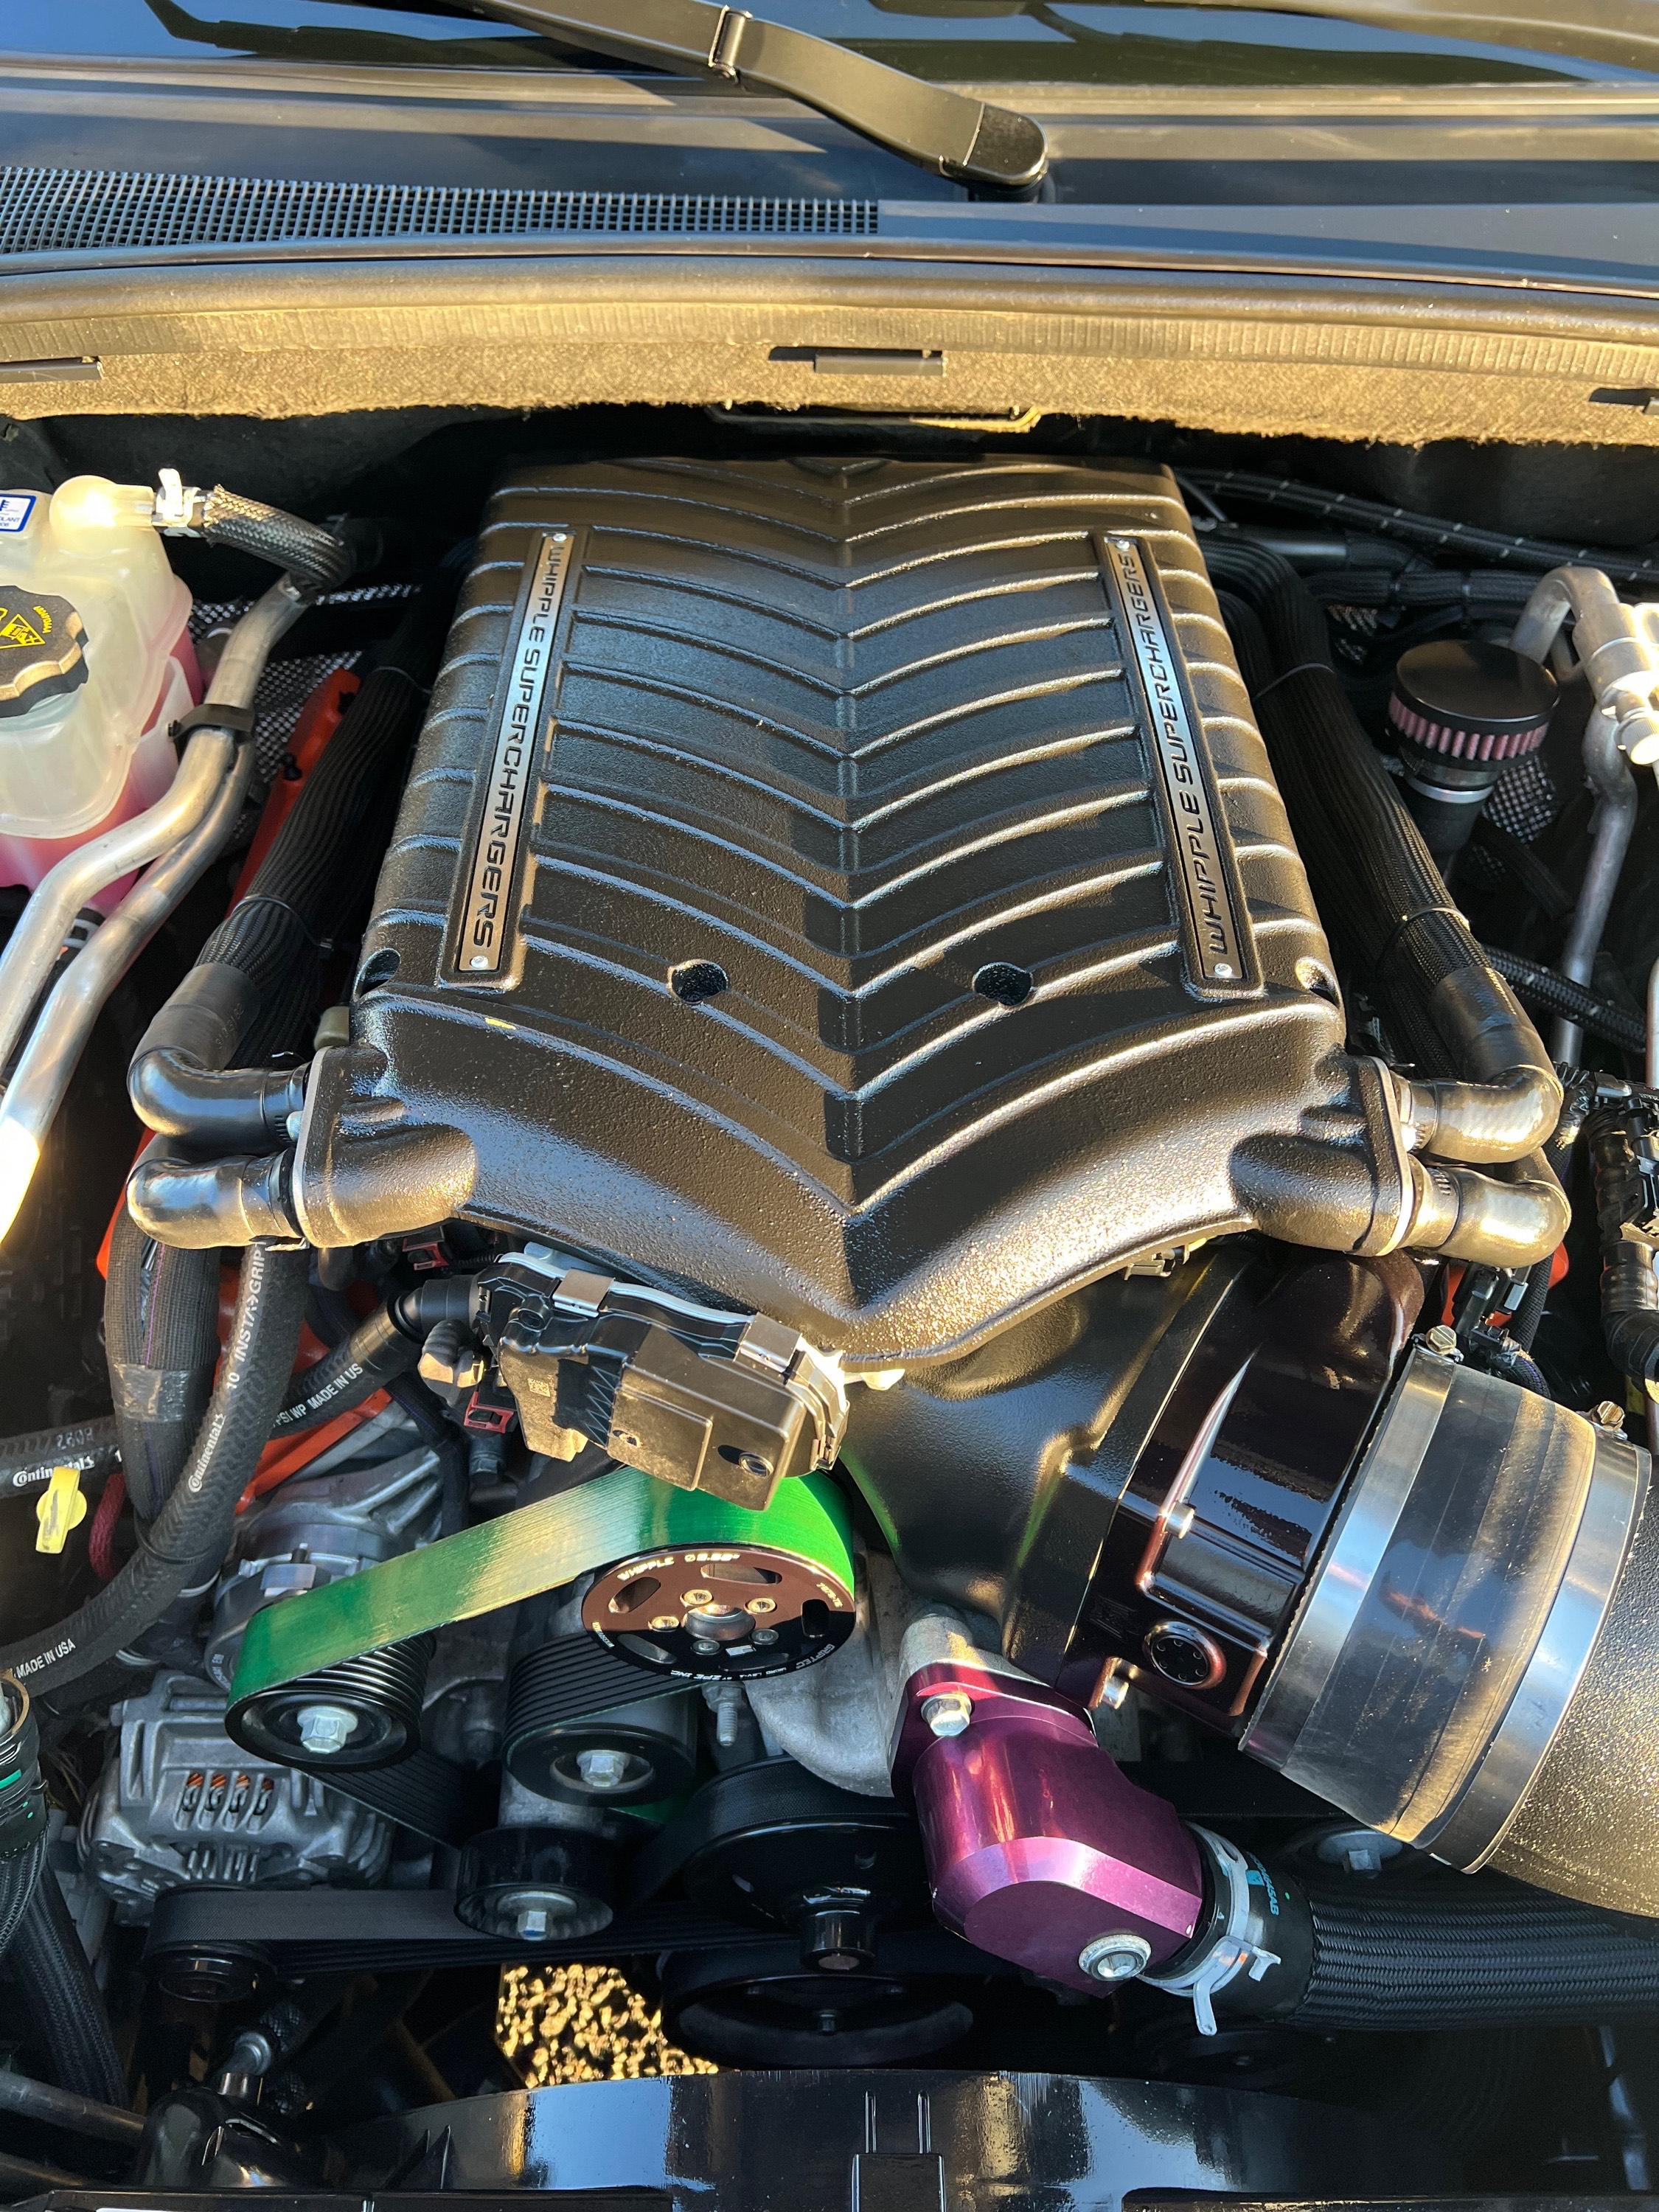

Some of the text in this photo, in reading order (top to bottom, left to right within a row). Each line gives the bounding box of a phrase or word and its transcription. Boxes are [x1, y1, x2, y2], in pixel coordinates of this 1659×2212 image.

[473, 546, 565, 948] WHIPPLE SUPERCHARGERS
[1118, 553, 1228, 954] WHIPPLE SUPERCHARGERS
[293, 1403, 307, 1422] WP
[307, 1385, 339, 1410] MADE
[333, 1375, 349, 1391] IN
[188, 1420, 223, 1492] Continental
[17, 1638, 77, 1679] MADE IN USA
